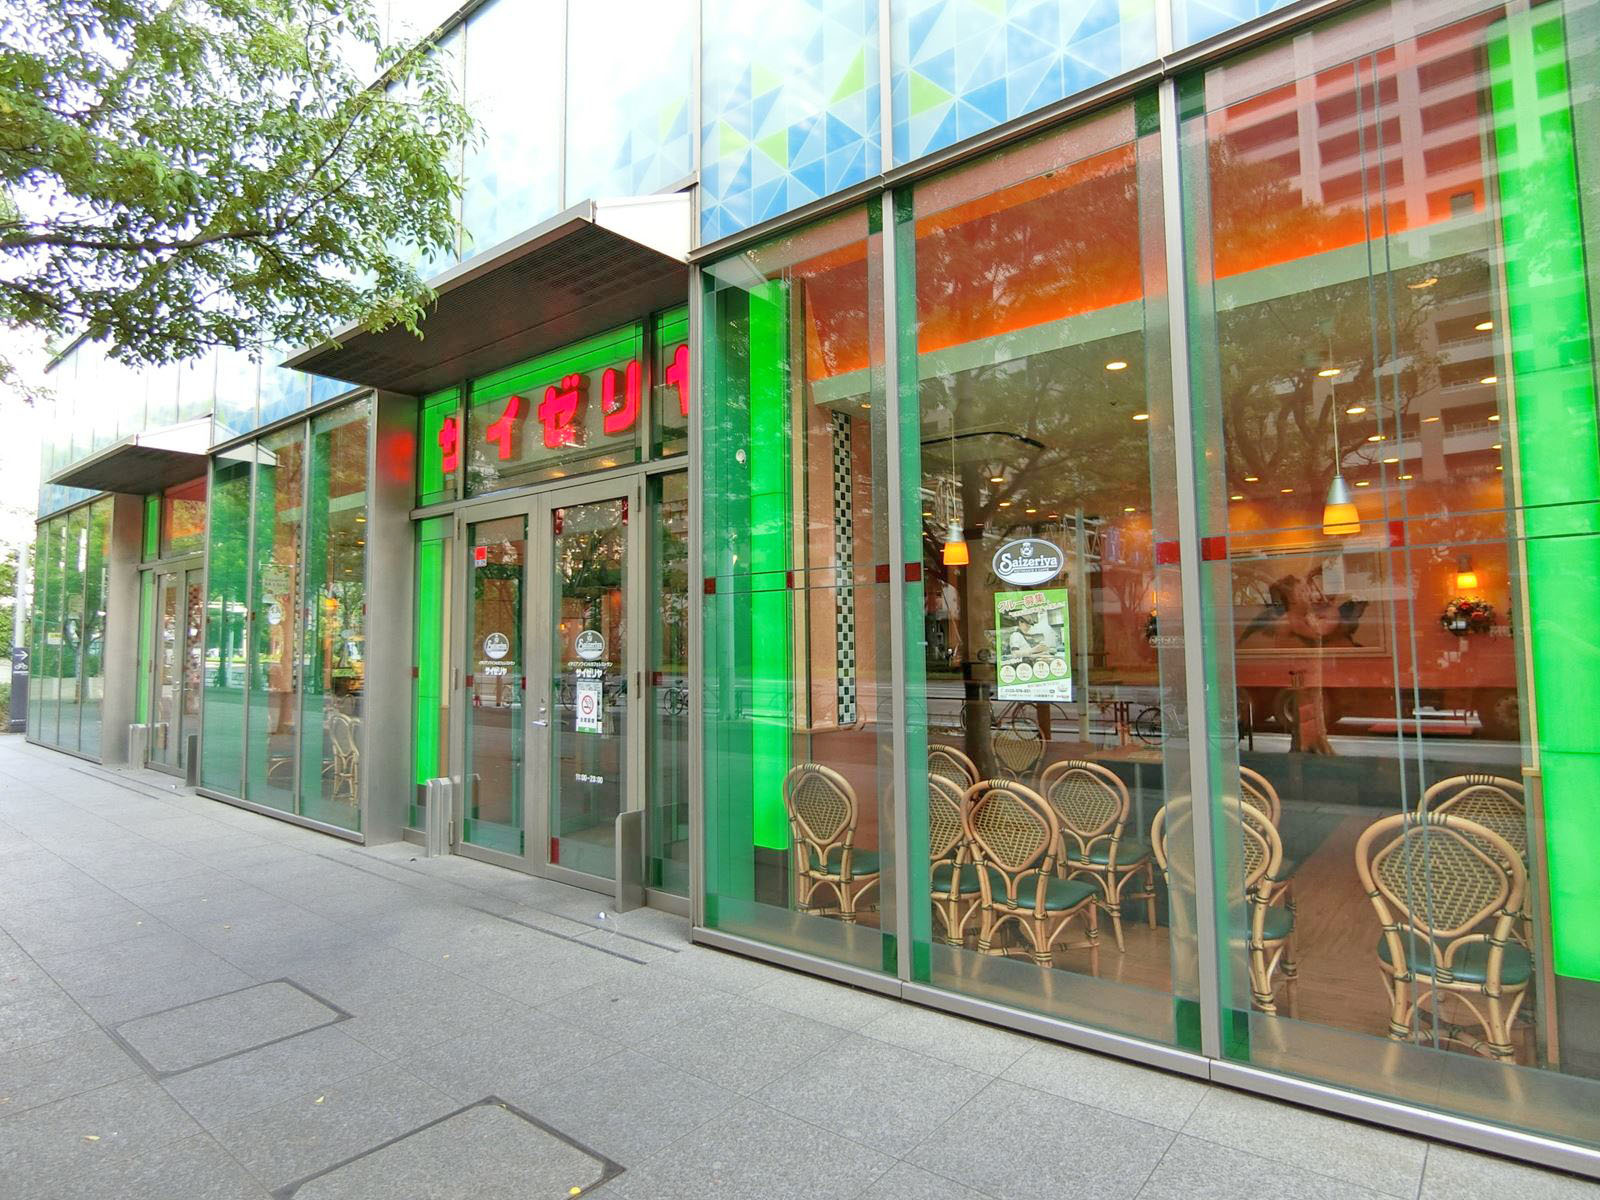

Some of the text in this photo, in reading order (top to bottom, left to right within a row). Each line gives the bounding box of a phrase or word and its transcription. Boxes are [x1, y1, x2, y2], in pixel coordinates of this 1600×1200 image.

[999, 552, 1058, 572] Saizeriya
[575, 668, 603, 678] サイゼリヤ
